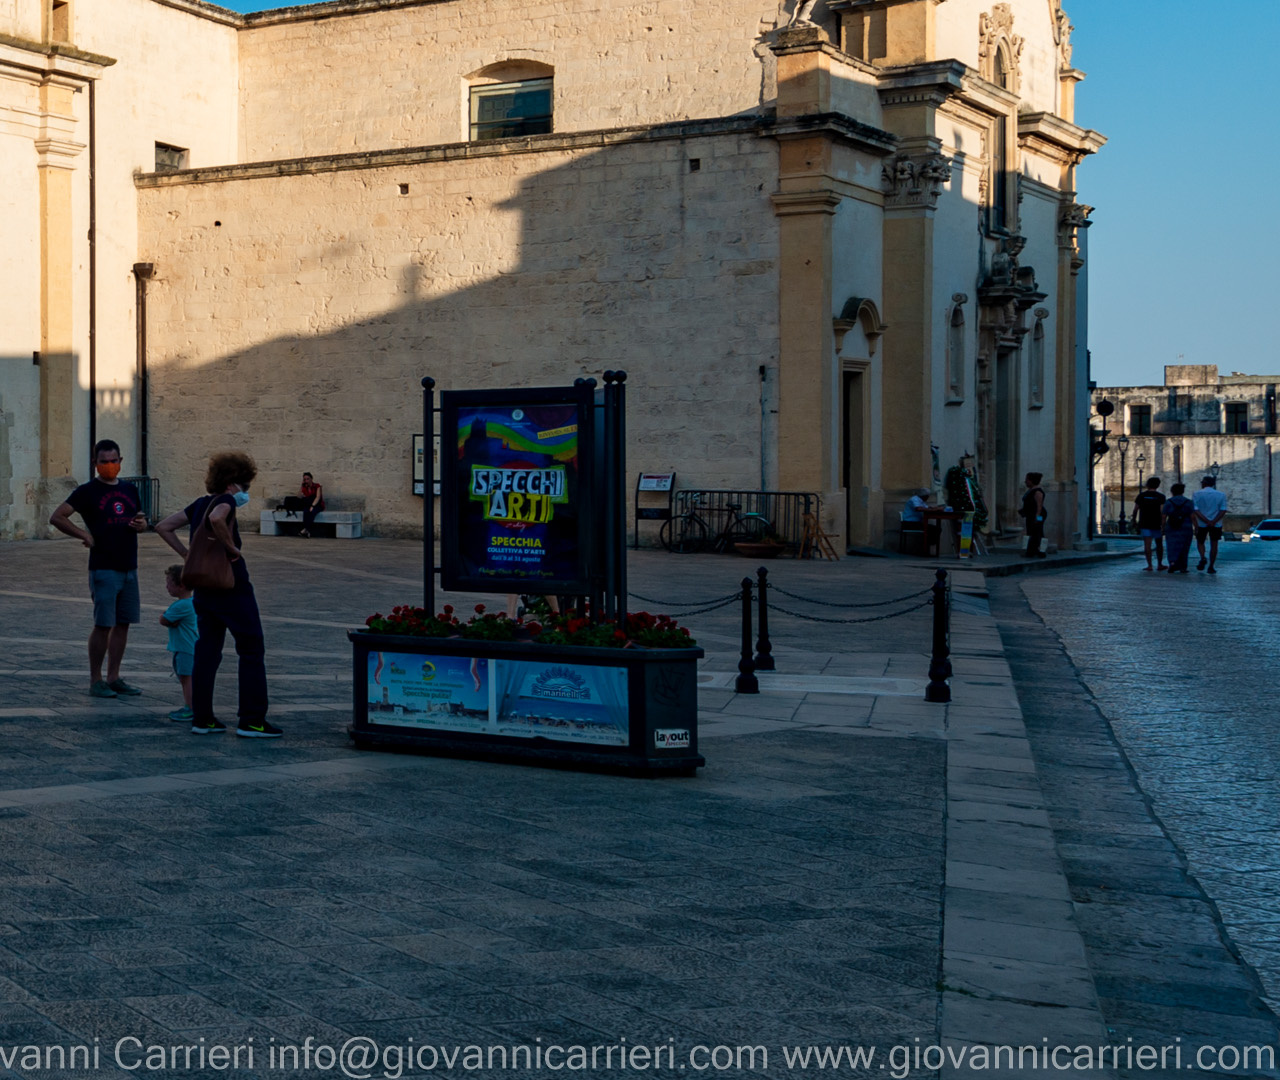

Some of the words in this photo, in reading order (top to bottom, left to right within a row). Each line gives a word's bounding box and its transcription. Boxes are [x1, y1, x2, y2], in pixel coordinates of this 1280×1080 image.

[475, 470, 562, 495] SPECCHI
[491, 536, 542, 548] SPECCHIA
[543, 688, 579, 700] marinelli
[656, 731, 688, 746] layout
